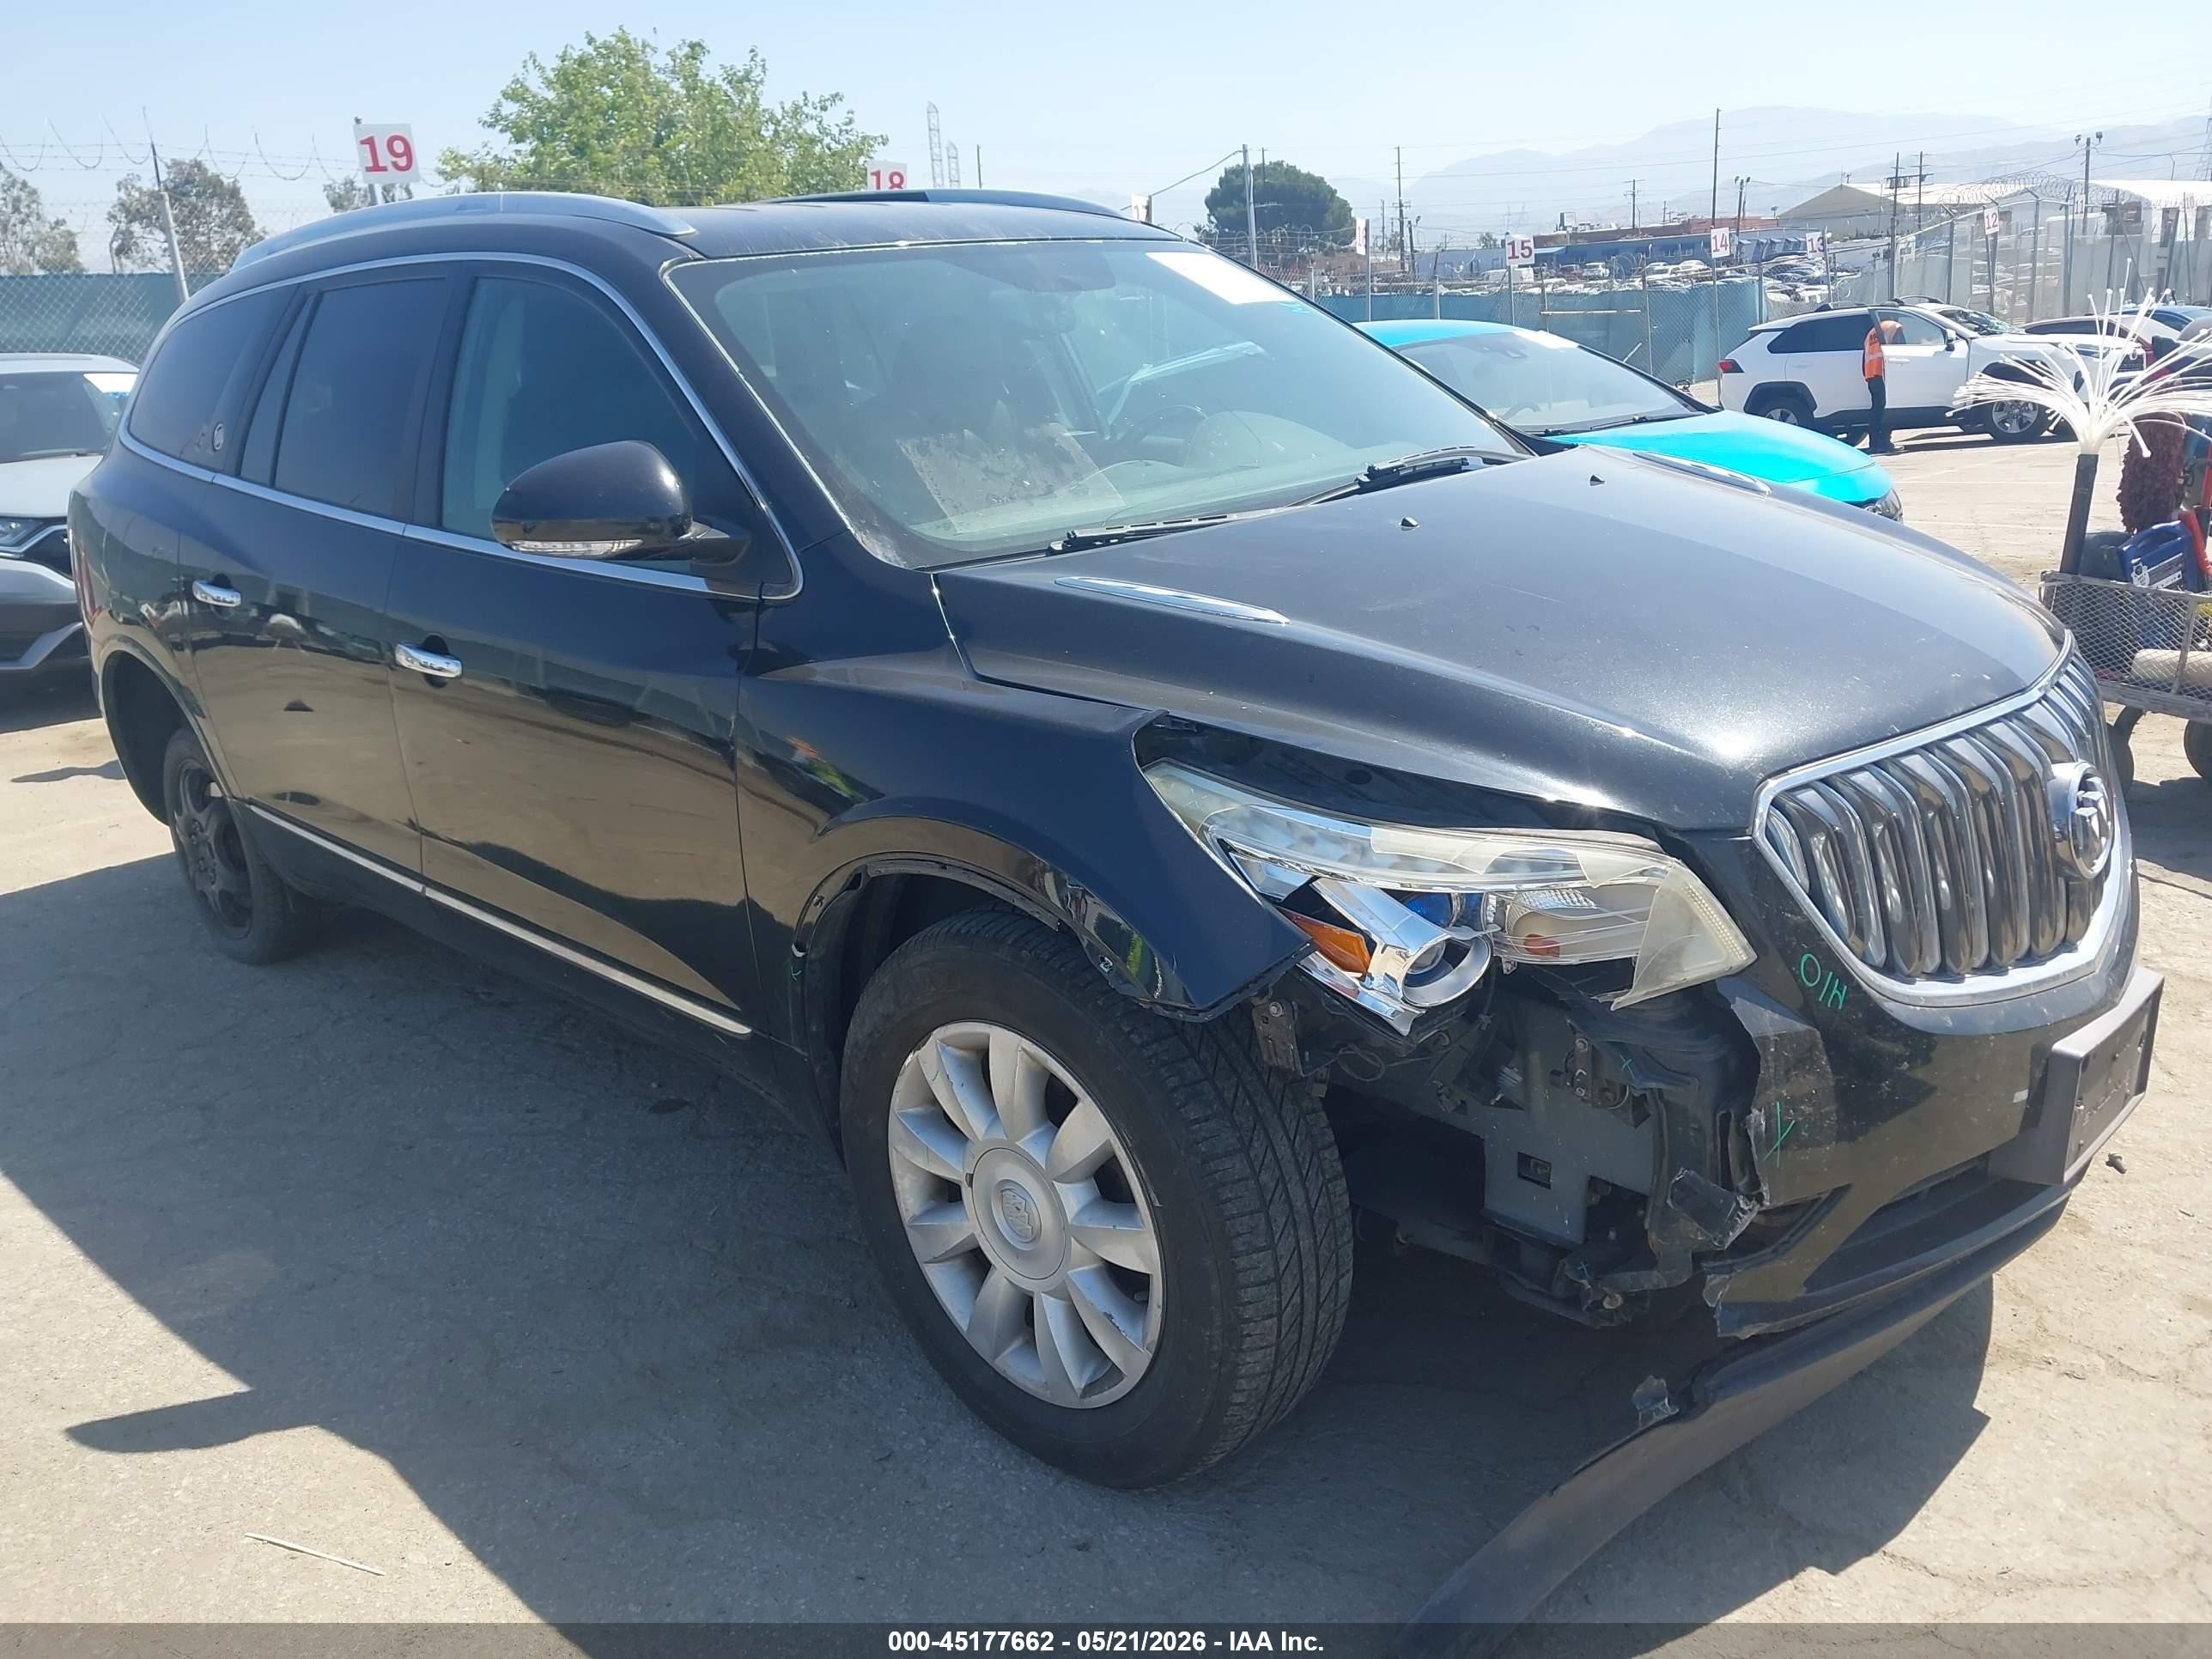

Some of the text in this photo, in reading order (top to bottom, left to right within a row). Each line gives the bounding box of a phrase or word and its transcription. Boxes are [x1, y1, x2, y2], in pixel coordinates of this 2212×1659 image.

[359, 134, 414, 173] 19
[2074, 199, 2084, 215] 11
[1985, 212, 1999, 230] 12
[1507, 239, 1534, 260] 15
[1711, 231, 1729, 252] 14
[1808, 236, 1826, 254] 13
